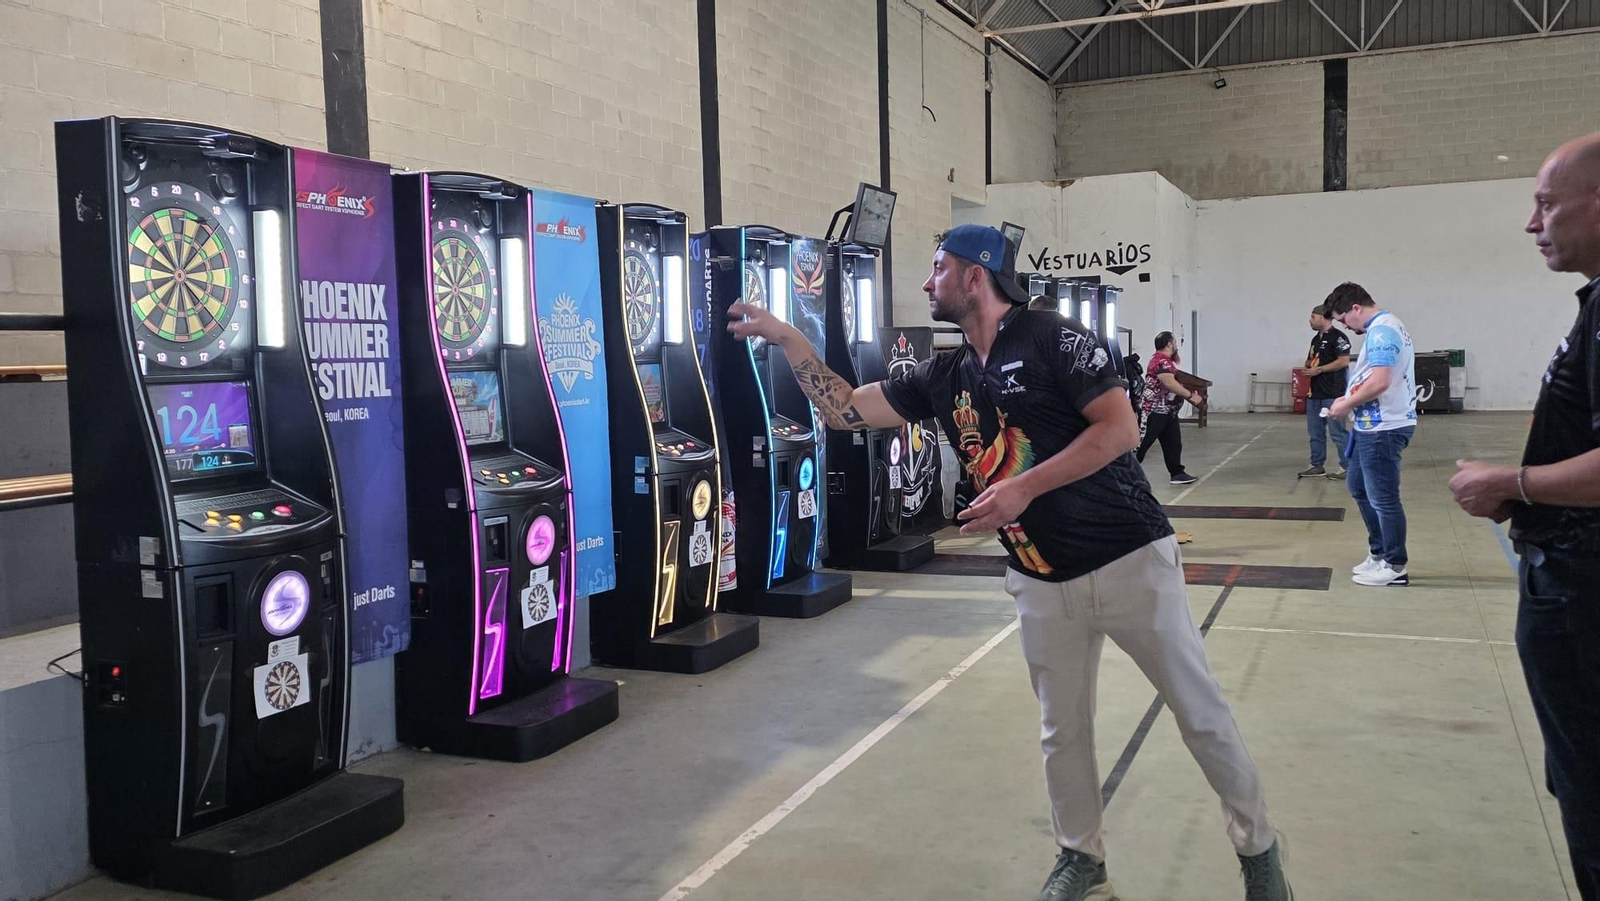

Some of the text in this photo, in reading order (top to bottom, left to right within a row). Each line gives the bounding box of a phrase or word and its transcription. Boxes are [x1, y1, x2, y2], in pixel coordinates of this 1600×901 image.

[151, 186, 159, 197] 5
[171, 185, 182, 195] 20
[194, 191, 200, 201] 1
[130, 197, 141, 207] 12
[212, 206, 221, 216] 18
[228, 225, 235, 235] 4
[237, 250, 246, 259] 13
[242, 274, 249, 284] 6
[239, 299, 248, 309] 10
[300, 280, 388, 320] HOENIX
[551, 313, 581, 328] PHOENIX
[230, 322, 240, 331] 15
[546, 324, 587, 343] SUMMER
[218, 340, 226, 349] 2
[304, 322, 390, 360] UMMER
[1060, 326, 1086, 353] SKY
[156, 352, 167, 363] 19
[199, 352, 209, 362] 17
[547, 343, 588, 362] FESTIVAL
[180, 356, 188, 366] 3
[311, 361, 392, 400] STIVAL
[325, 407, 369, 423] eoul, KOREA
[157, 402, 222, 446] 124
[175, 458, 193, 471] 177
[201, 455, 220, 468] 124
[576, 535, 604, 552] ust Darts
[353, 584, 396, 611] just Darts
